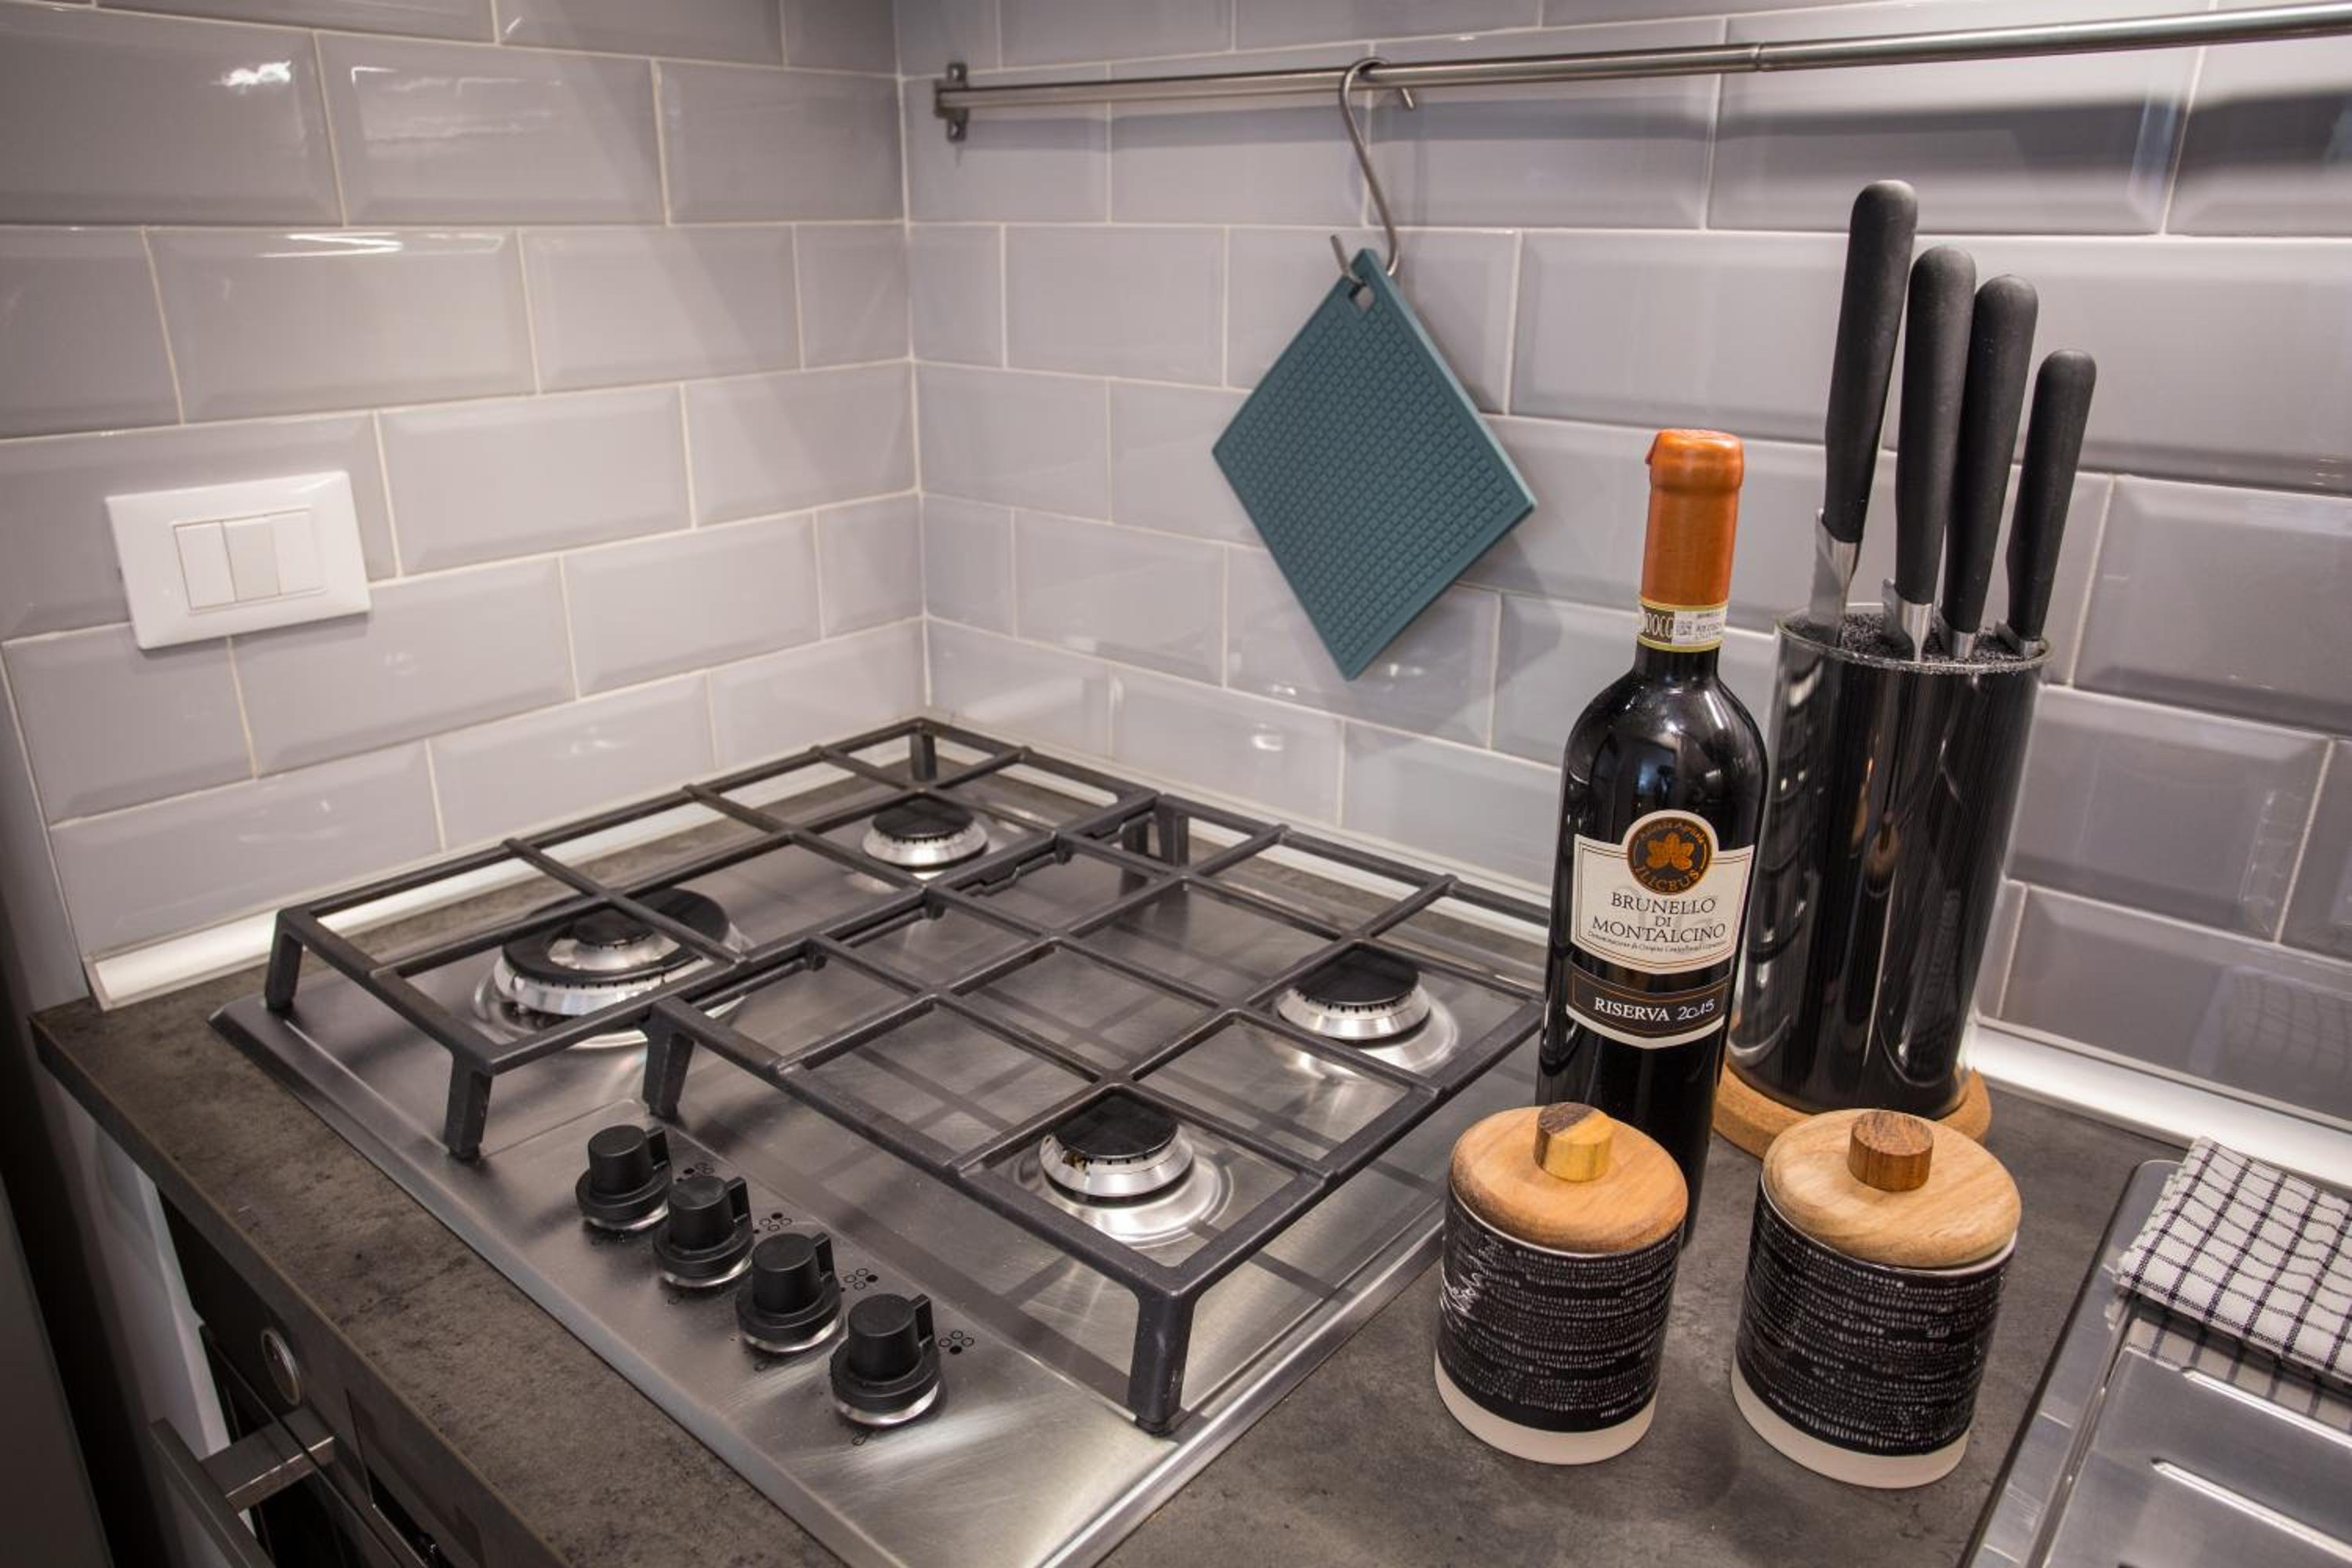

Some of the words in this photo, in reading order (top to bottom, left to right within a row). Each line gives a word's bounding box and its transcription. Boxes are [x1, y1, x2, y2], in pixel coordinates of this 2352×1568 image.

[1611, 891, 1716, 915] BRUNELLO
[1592, 916, 1726, 943] MONTALCINO
[1655, 916, 1671, 927] DI
[1594, 996, 1670, 1022] RISERVA
[1676, 998, 1715, 1020] 2015
